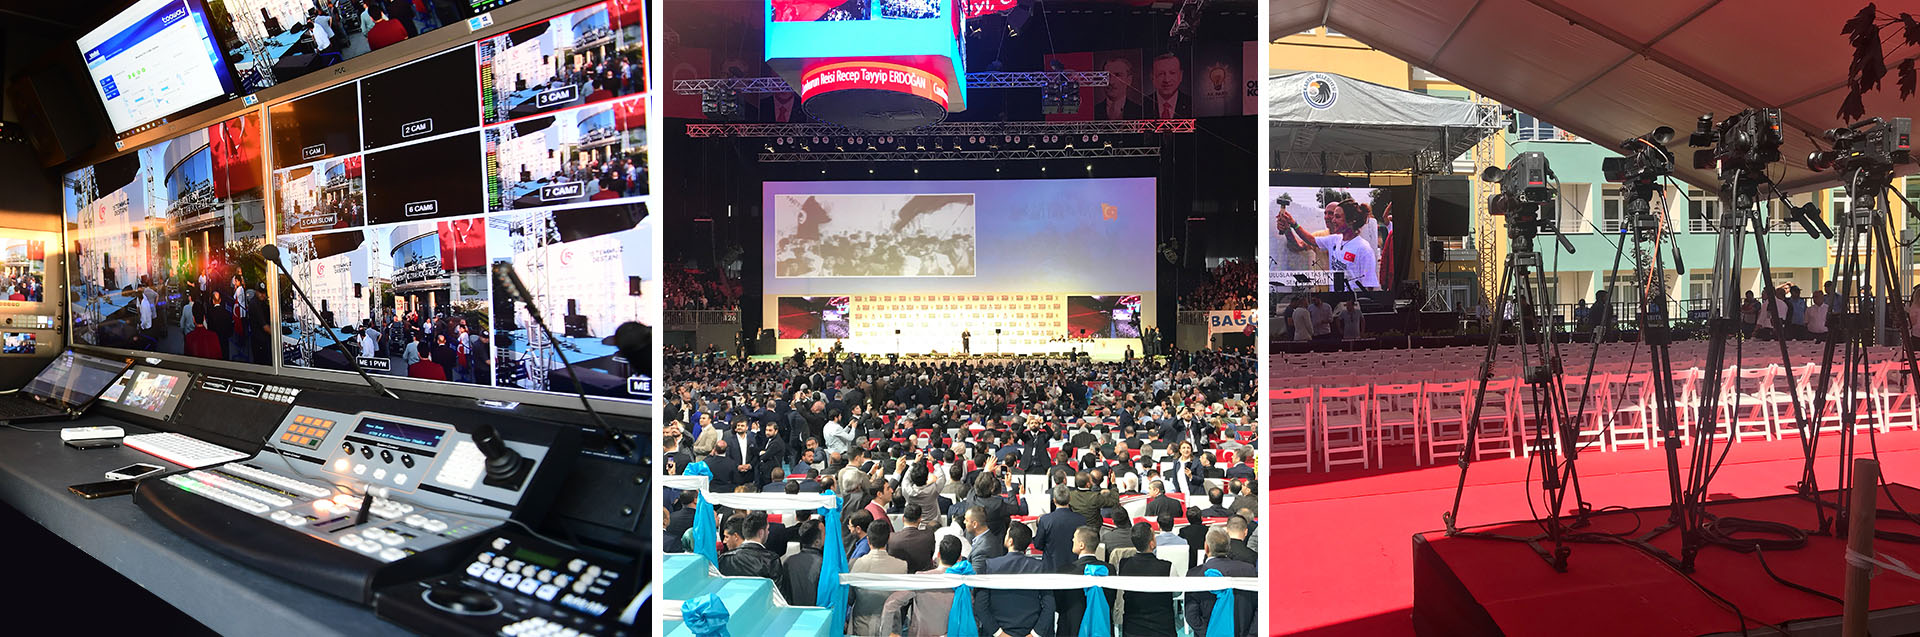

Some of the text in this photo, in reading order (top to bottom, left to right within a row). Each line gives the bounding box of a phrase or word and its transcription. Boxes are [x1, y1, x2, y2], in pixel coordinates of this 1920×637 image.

[161, 7, 186, 24] tooway
[820, 71, 835, 85] Reisi
[836, 69, 860, 83] Recep
[860, 68, 888, 84] Tayyip
[889, 70, 926, 89] ERDOĞAN
[541, 90, 570, 103] 3 CAM
[405, 123, 426, 134] 2 CAM
[309, 147, 321, 156] CAM
[545, 185, 579, 197] 7 CAM7
[306, 217, 318, 226] CAM
[318, 215, 334, 225] SLOW
[358, 359, 369, 367] ME
[373, 360, 388, 368] PVW
[633, 381, 650, 392] ME
